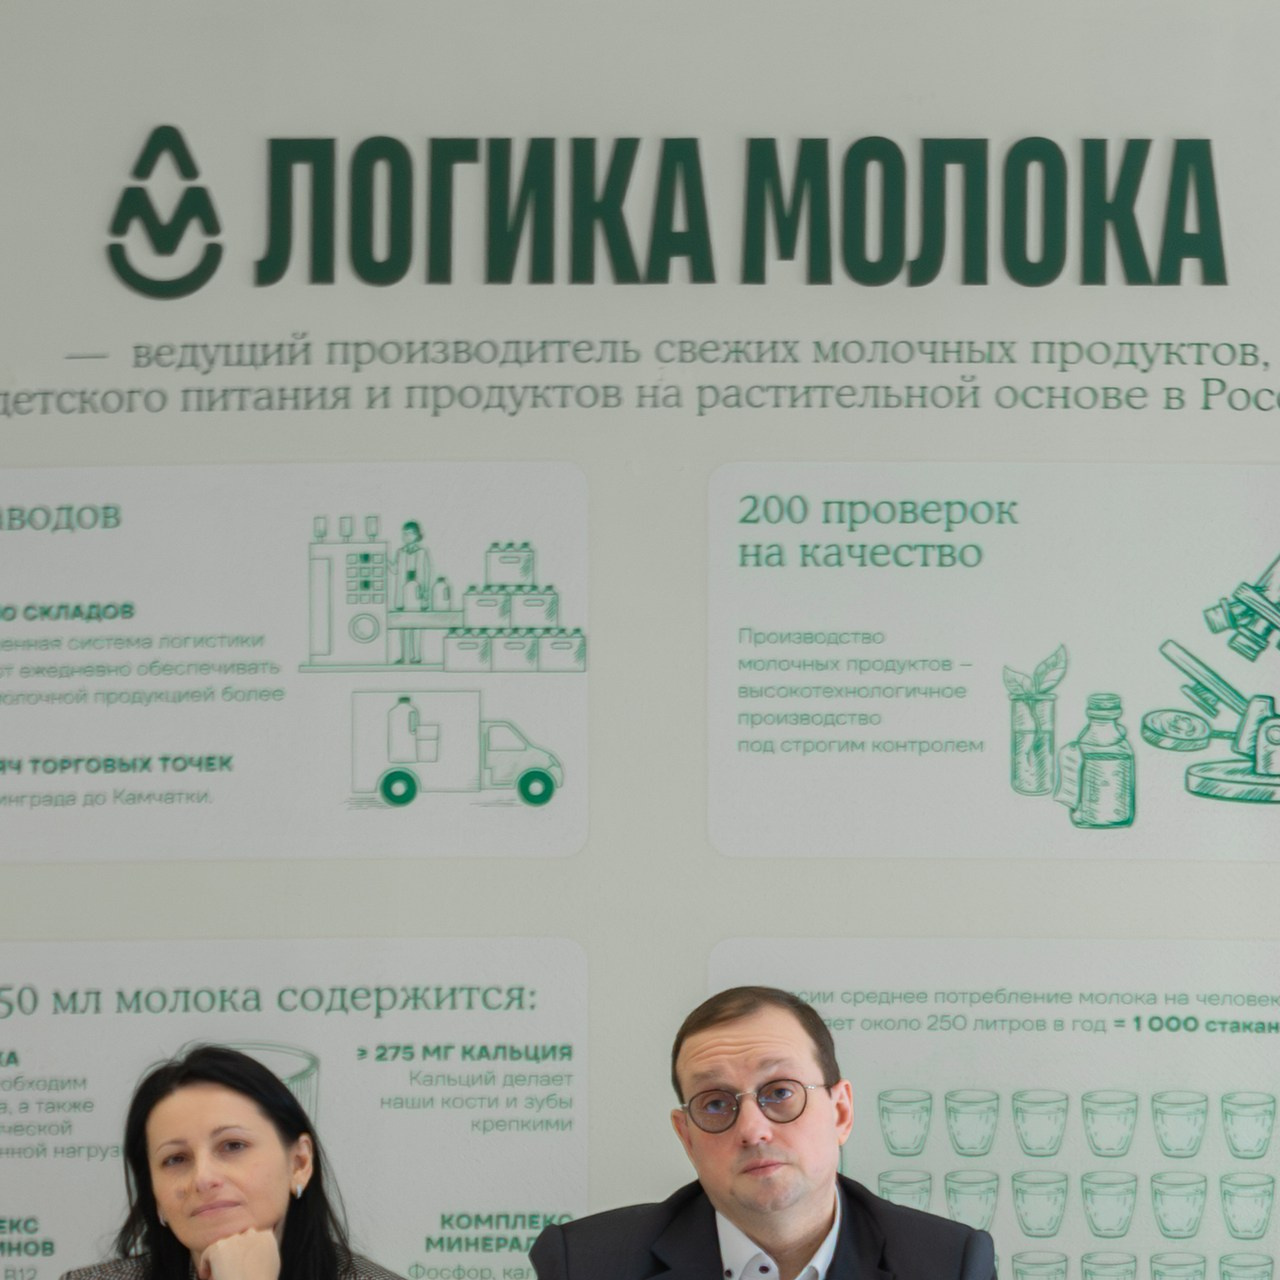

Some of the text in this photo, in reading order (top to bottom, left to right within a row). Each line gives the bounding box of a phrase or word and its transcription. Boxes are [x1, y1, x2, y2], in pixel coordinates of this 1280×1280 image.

[254, 135, 1229, 288] ЛОГИКА МОЛОКА
[133, 332, 312, 375] ведущий
[326, 340, 641, 373] производитель
[655, 340, 800, 364] свежих
[812, 340, 1017, 364] молочных
[1032, 341, 1269, 374] продуктов,
[181, 386, 351, 412] питания
[366, 386, 391, 409] и
[405, 384, 623, 417] продуктов
[636, 385, 683, 408] на
[696, 375, 980, 417] растительной
[995, 385, 1148, 410] основе
[1164, 387, 1185, 410] в
[0, 504, 122, 533] водов
[738, 494, 1018, 532] 200 проверок
[739, 543, 983, 568] на качество
[23, 602, 135, 622] СКЛАДОВ
[69, 636, 154, 649] система
[159, 634, 265, 648] логистики
[738, 627, 885, 647] Производство
[19, 664, 131, 679] ежедневно
[137, 660, 280, 676] обеспечивать
[738, 658, 953, 675] молочных продуктов
[93, 686, 215, 706] продукцией
[221, 685, 286, 702] более
[738, 685, 967, 699] высокотехнологичное
[738, 712, 882, 728] производство
[737, 739, 984, 756] под строгим контролем
[29, 757, 152, 774] ТОРГОВЫХ
[159, 755, 233, 772] ТОЧЕК
[82, 792, 107, 807] до
[113, 789, 209, 805] Камчатки.
[52, 990, 101, 1014] мл
[116, 988, 262, 1014] молока
[277, 985, 536, 1019] содержится:
[840, 991, 928, 1007] среднее
[934, 988, 1073, 1007] потребление
[1078, 992, 1158, 1005] молока
[1164, 993, 1190, 1005] на
[860, 1018, 922, 1031] около
[927, 1014, 968, 1031] 250
[973, 1018, 1047, 1034] литров
[1053, 1019, 1064, 1031] в
[1072, 1019, 1107, 1033] год
[375, 1044, 573, 1063] 275 МГ КАЛЬЦИЯ
[409, 1070, 573, 1087] Кальций делает
[19, 1101, 29, 1113] а
[37, 1100, 94, 1113] также
[380, 1093, 573, 1112] наши кости и зубы
[471, 1118, 573, 1135] крепкими
[54, 1144, 124, 1162] нагруз
